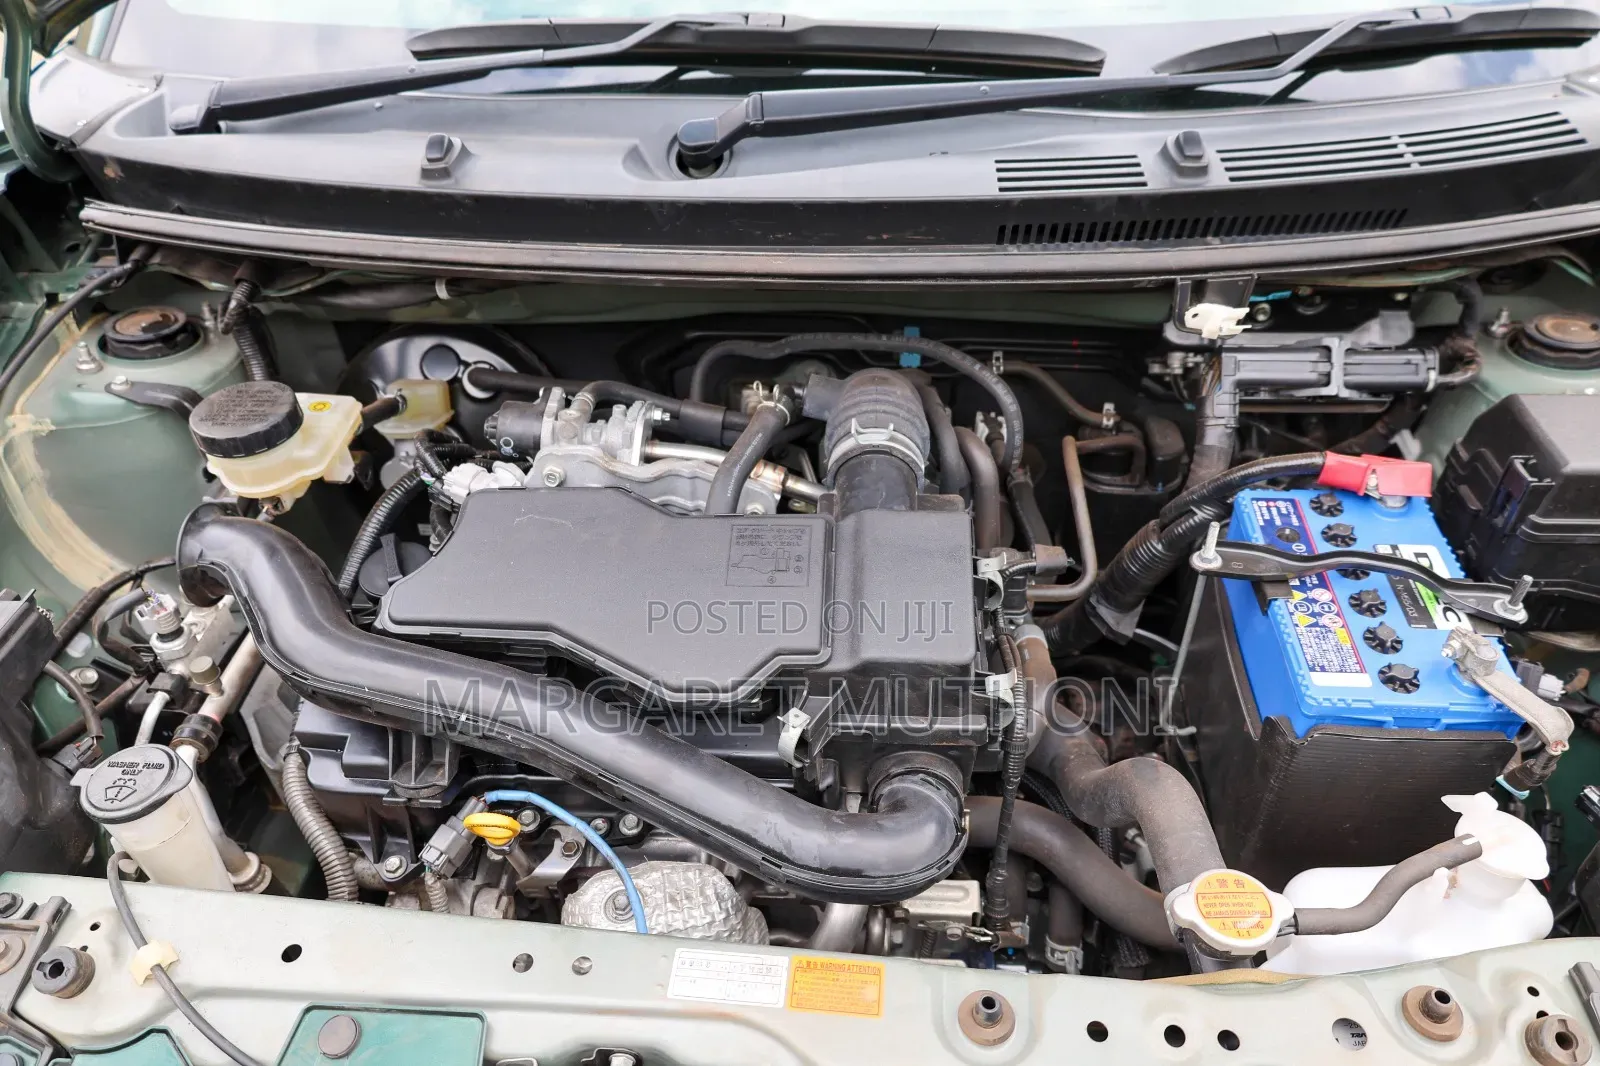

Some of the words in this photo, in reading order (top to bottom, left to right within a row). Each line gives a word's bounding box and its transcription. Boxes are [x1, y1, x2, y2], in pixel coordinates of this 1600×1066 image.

[107, 761, 139, 769] WASHER
[821, 962, 846, 972] WARNING
[847, 964, 880, 975] ATTENTION
